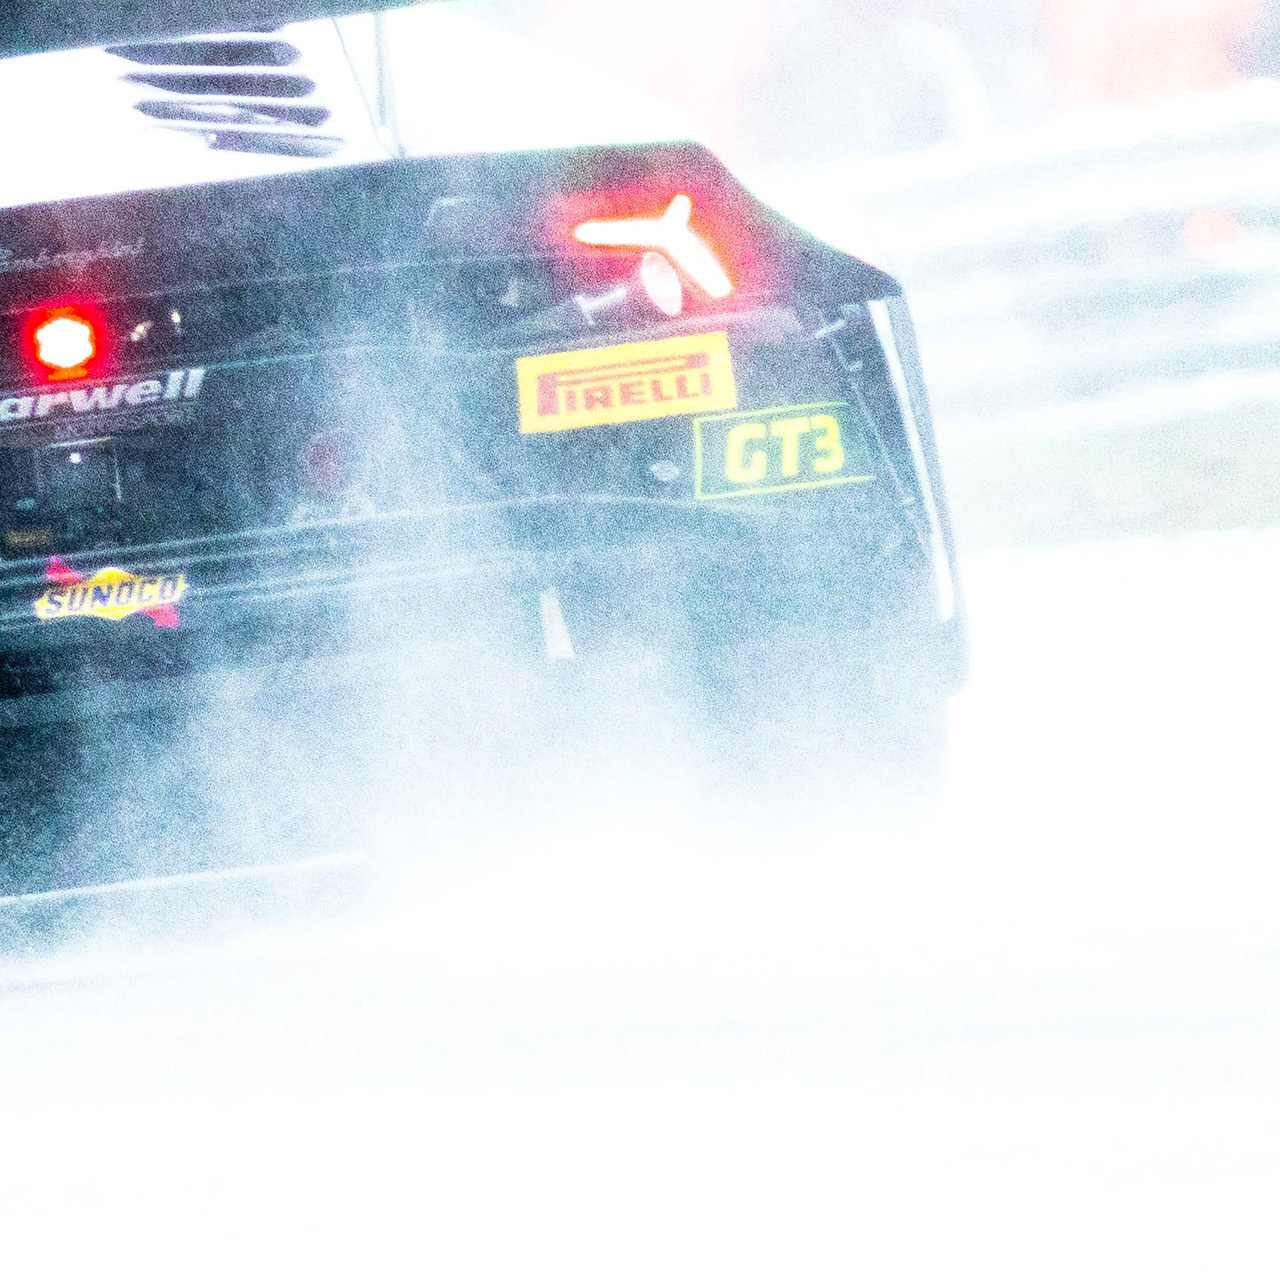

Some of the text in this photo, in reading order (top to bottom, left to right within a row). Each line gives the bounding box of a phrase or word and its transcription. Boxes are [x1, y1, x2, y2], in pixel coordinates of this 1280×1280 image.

[537, 352, 711, 416] PIRELLI
[724, 415, 845, 484] GT3
[43, 577, 182, 614] SUNOCO
